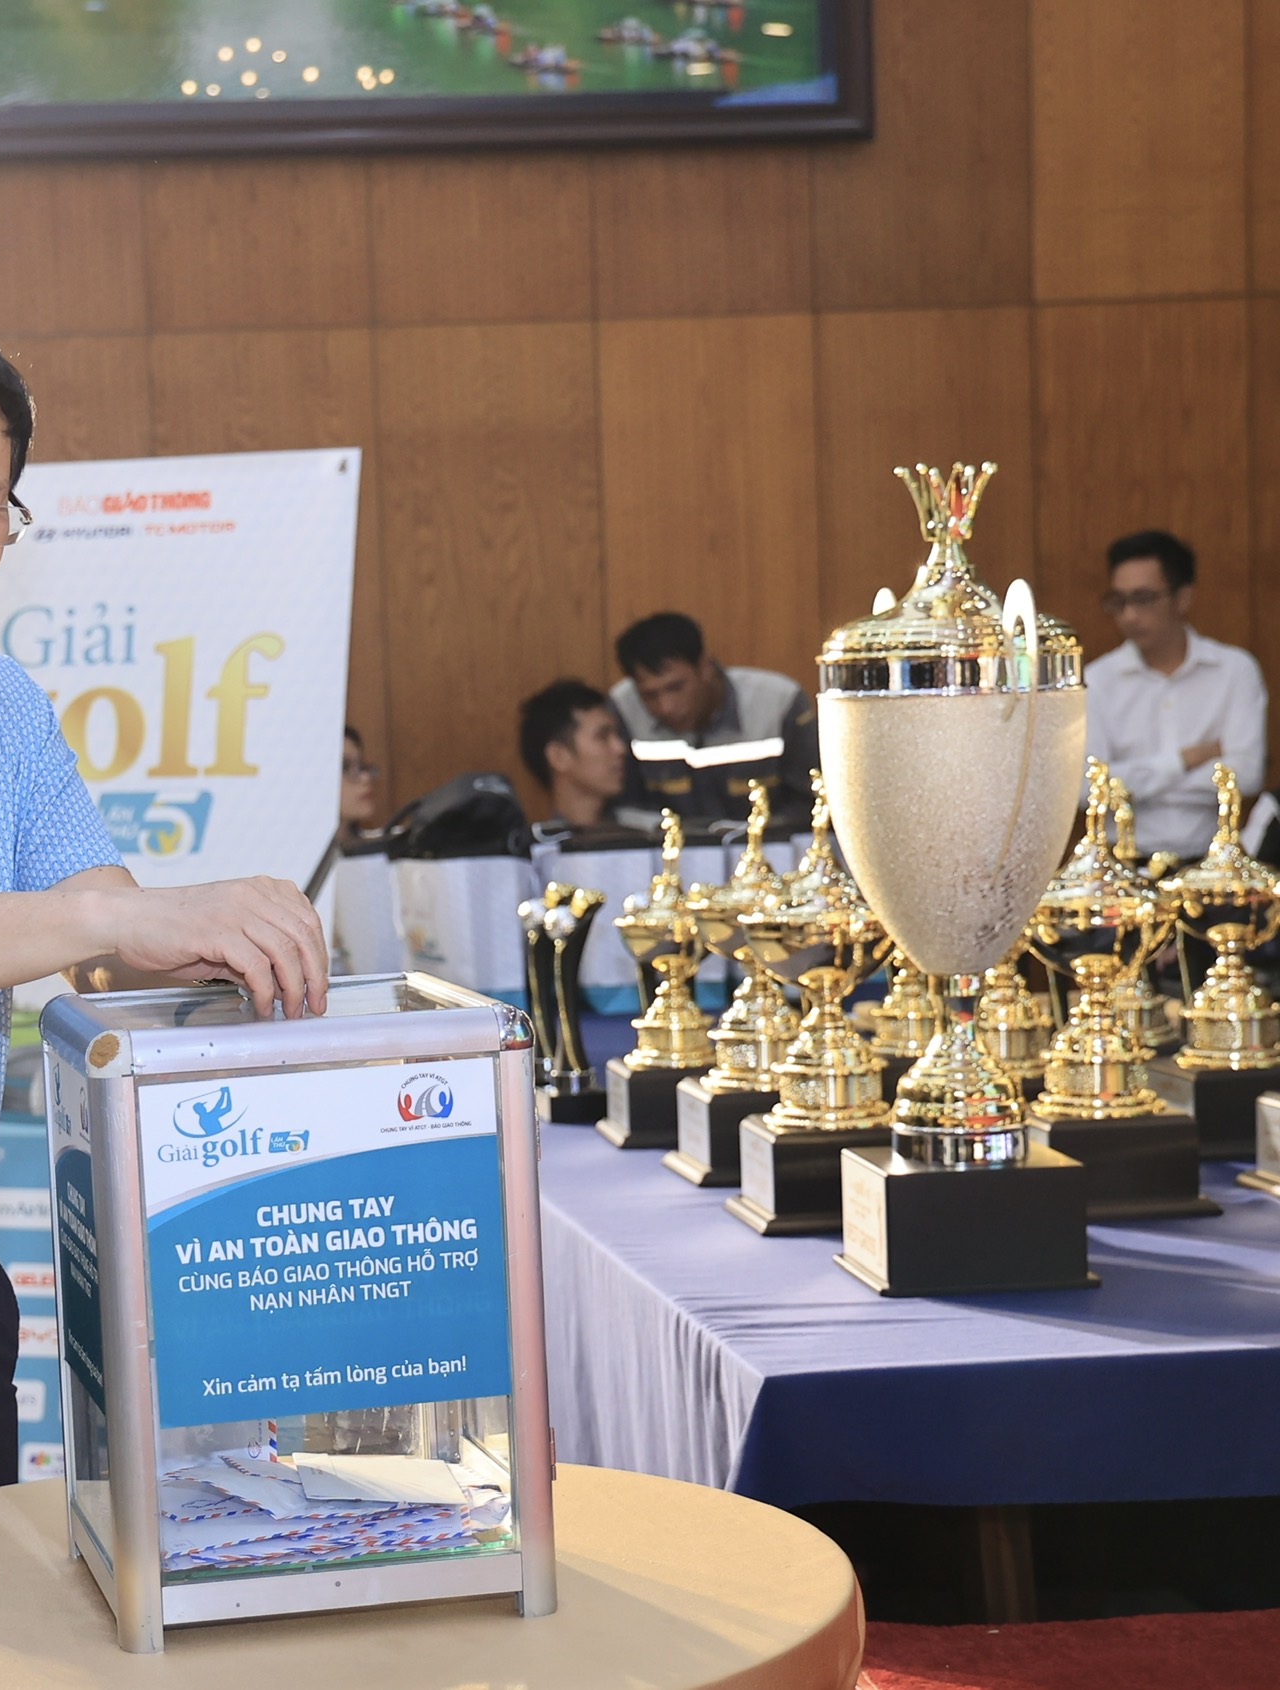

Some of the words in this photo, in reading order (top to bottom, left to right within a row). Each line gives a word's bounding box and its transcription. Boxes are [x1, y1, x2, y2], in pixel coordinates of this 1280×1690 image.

[1, 600, 138, 670] Giải
[47, 632, 286, 784] olf
[157, 1143, 199, 1163] Giải
[202, 1128, 264, 1168] golf
[256, 1200, 343, 1227] CHUNG
[348, 1196, 395, 1219] TAY
[175, 1237, 202, 1264] VÌ
[208, 1239, 244, 1262] AN
[249, 1229, 319, 1258] TOÀN
[325, 1226, 386, 1251] GIAO
[390, 1217, 478, 1246] THÔNG
[178, 1271, 233, 1293] CÙNG
[237, 1265, 279, 1288] BÁO
[283, 1263, 330, 1283] GIAO
[334, 1255, 402, 1279] THÔNG
[407, 1248, 435, 1273] HỖ
[439, 1248, 479, 1271] TRỢ
[250, 1291, 293, 1314] NẠN
[298, 1283, 355, 1307] NHÂN
[359, 1280, 412, 1301] TNGT
[202, 1378, 233, 1396] Xin
[237, 1374, 277, 1393] cảm
[280, 1372, 300, 1392] tạ
[304, 1366, 342, 1387] tấm
[346, 1364, 388, 1385] lòng
[391, 1359, 424, 1378] của
[428, 1355, 467, 1378] bạn!
